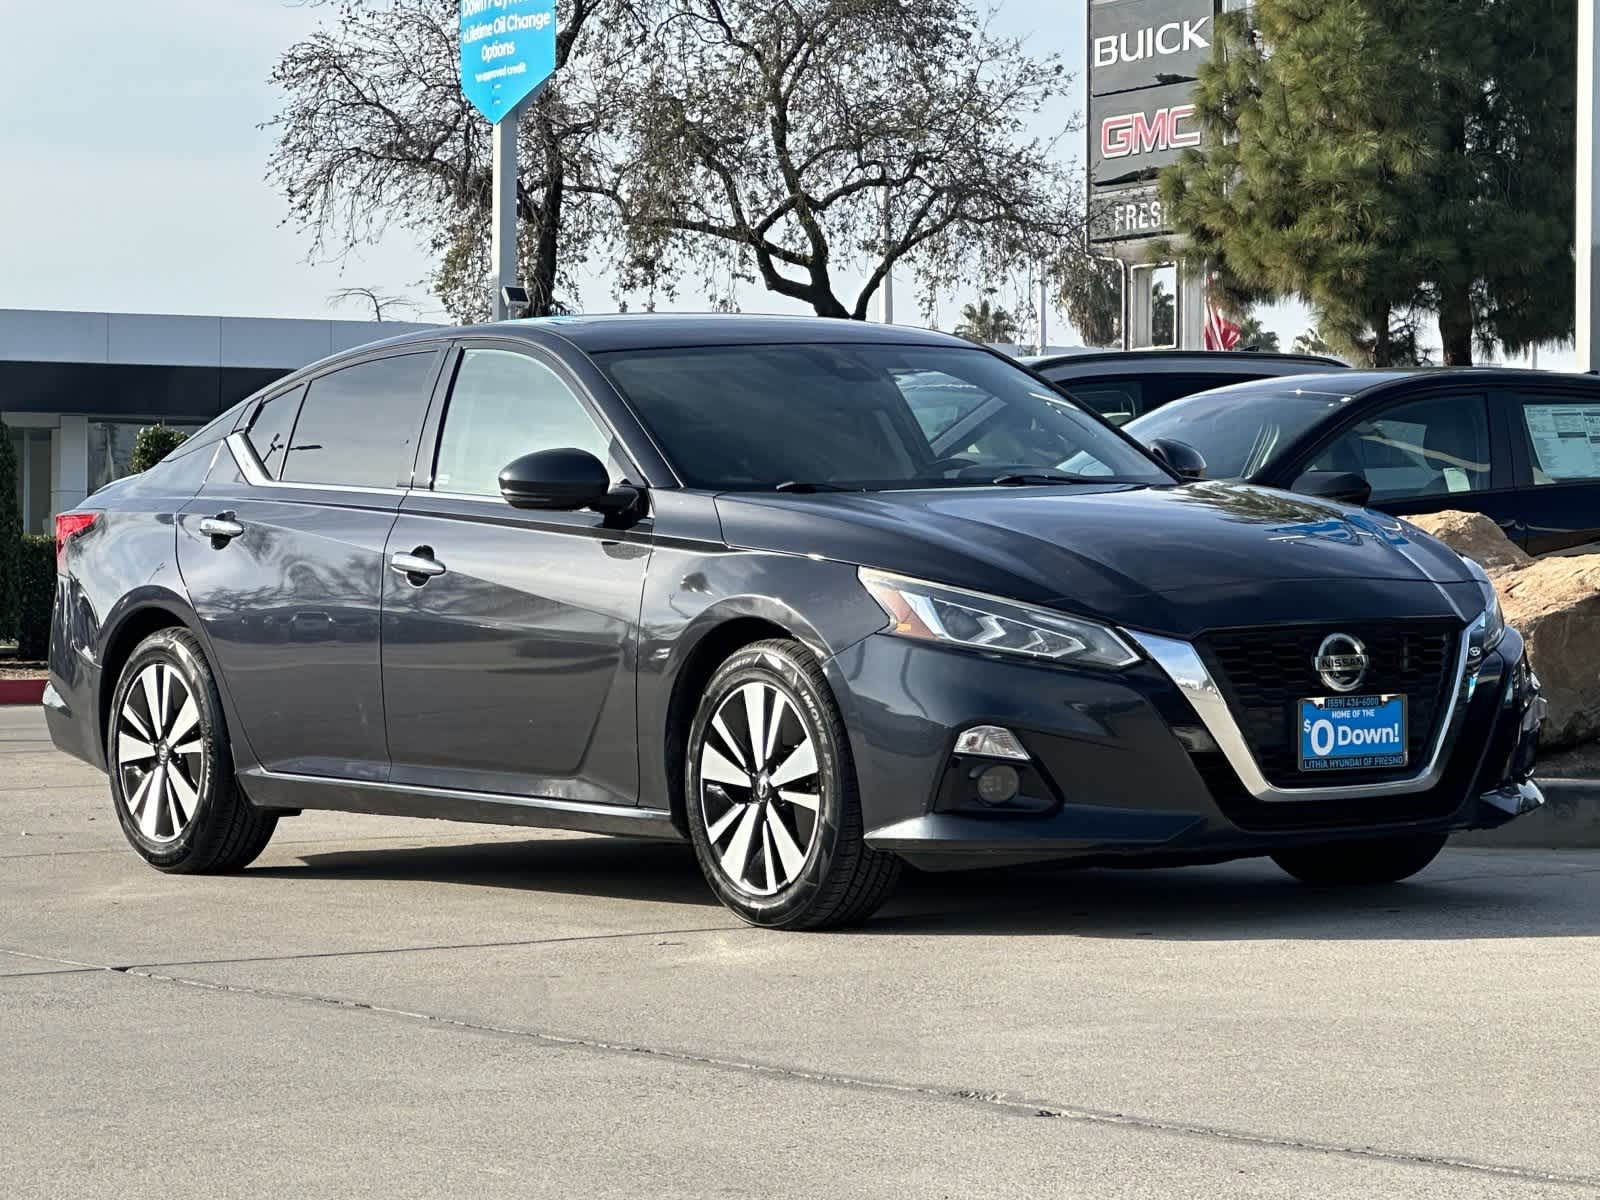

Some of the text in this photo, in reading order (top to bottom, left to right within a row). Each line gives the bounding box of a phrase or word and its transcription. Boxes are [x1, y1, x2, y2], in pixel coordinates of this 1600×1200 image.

[493, 17, 507, 33] Oil
[507, 12, 551, 30] Change
[481, 40, 516, 63] Options
[1094, 16, 1211, 67] BUICK
[1101, 103, 1201, 160] GMC
[1321, 656, 1363, 669] NISSAN
[1332, 708, 1375, 718] HOME OF THE
[1337, 723, 1400, 745] Down!
[1304, 755, 1404, 769] LITHIA HYUNDAI OF FRESNO
